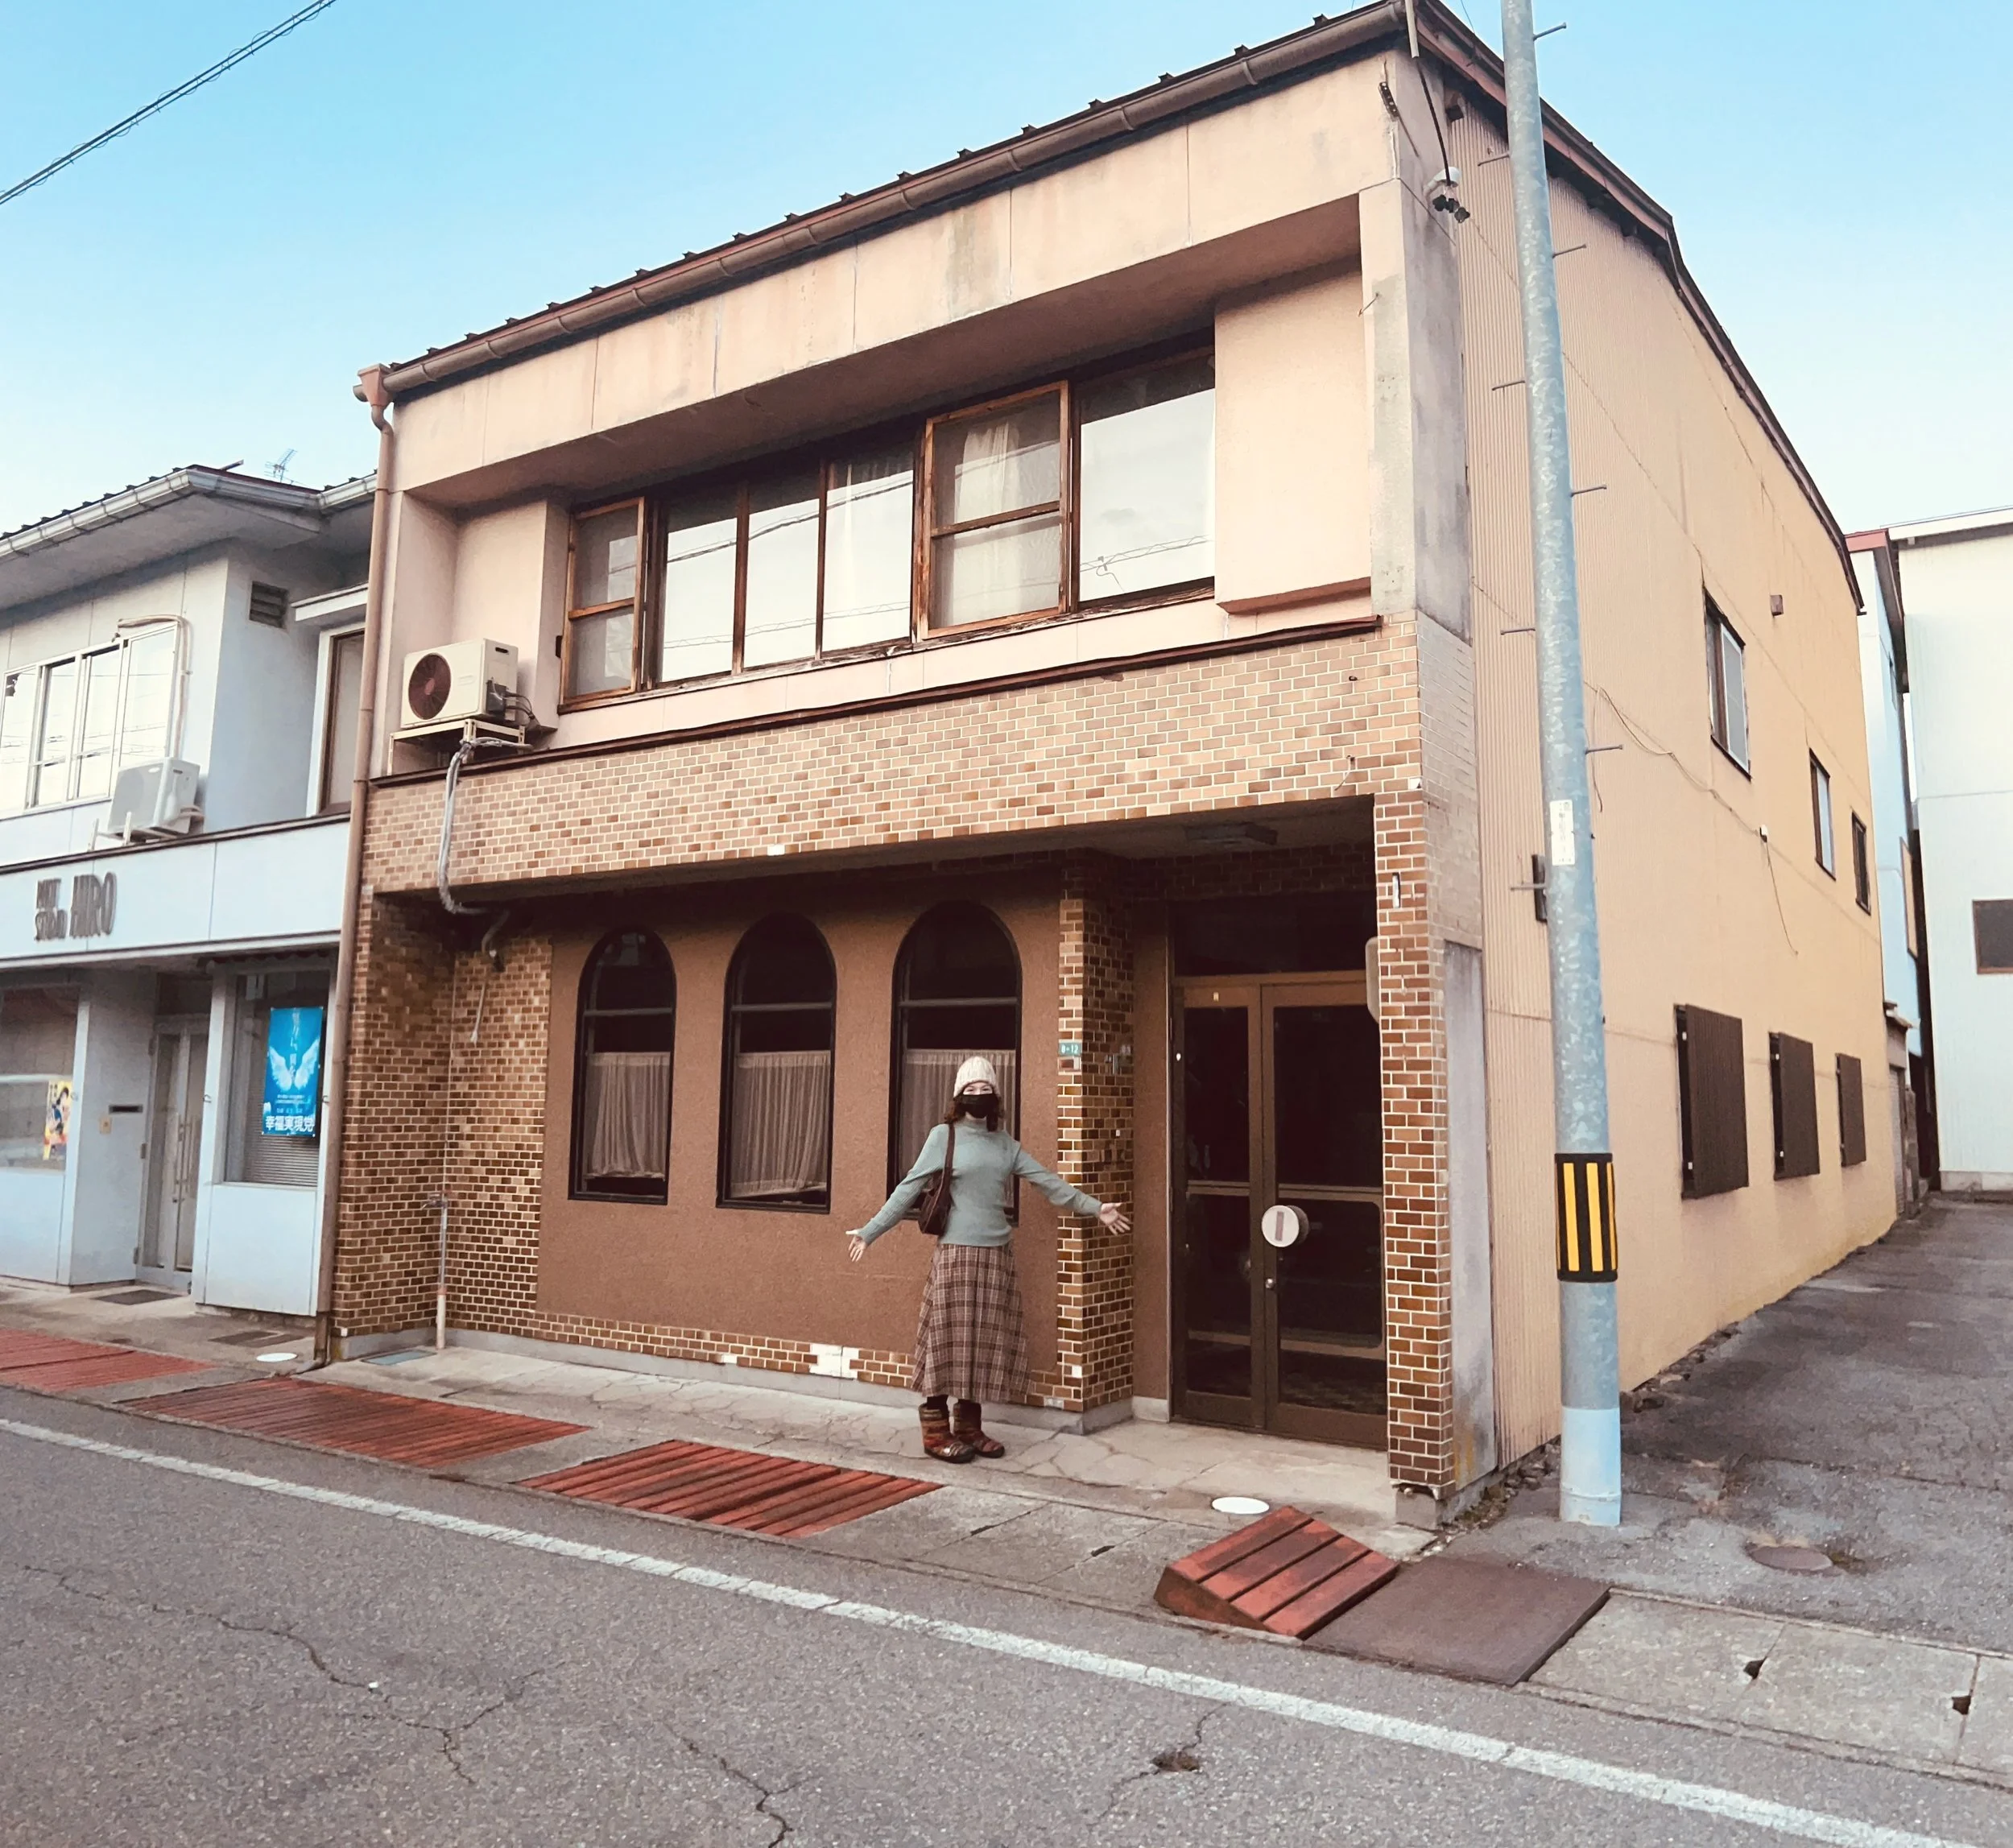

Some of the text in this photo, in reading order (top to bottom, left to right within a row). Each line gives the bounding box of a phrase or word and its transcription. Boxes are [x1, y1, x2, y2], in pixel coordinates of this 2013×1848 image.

[265, 1115, 316, 1132] 幸福実現党
